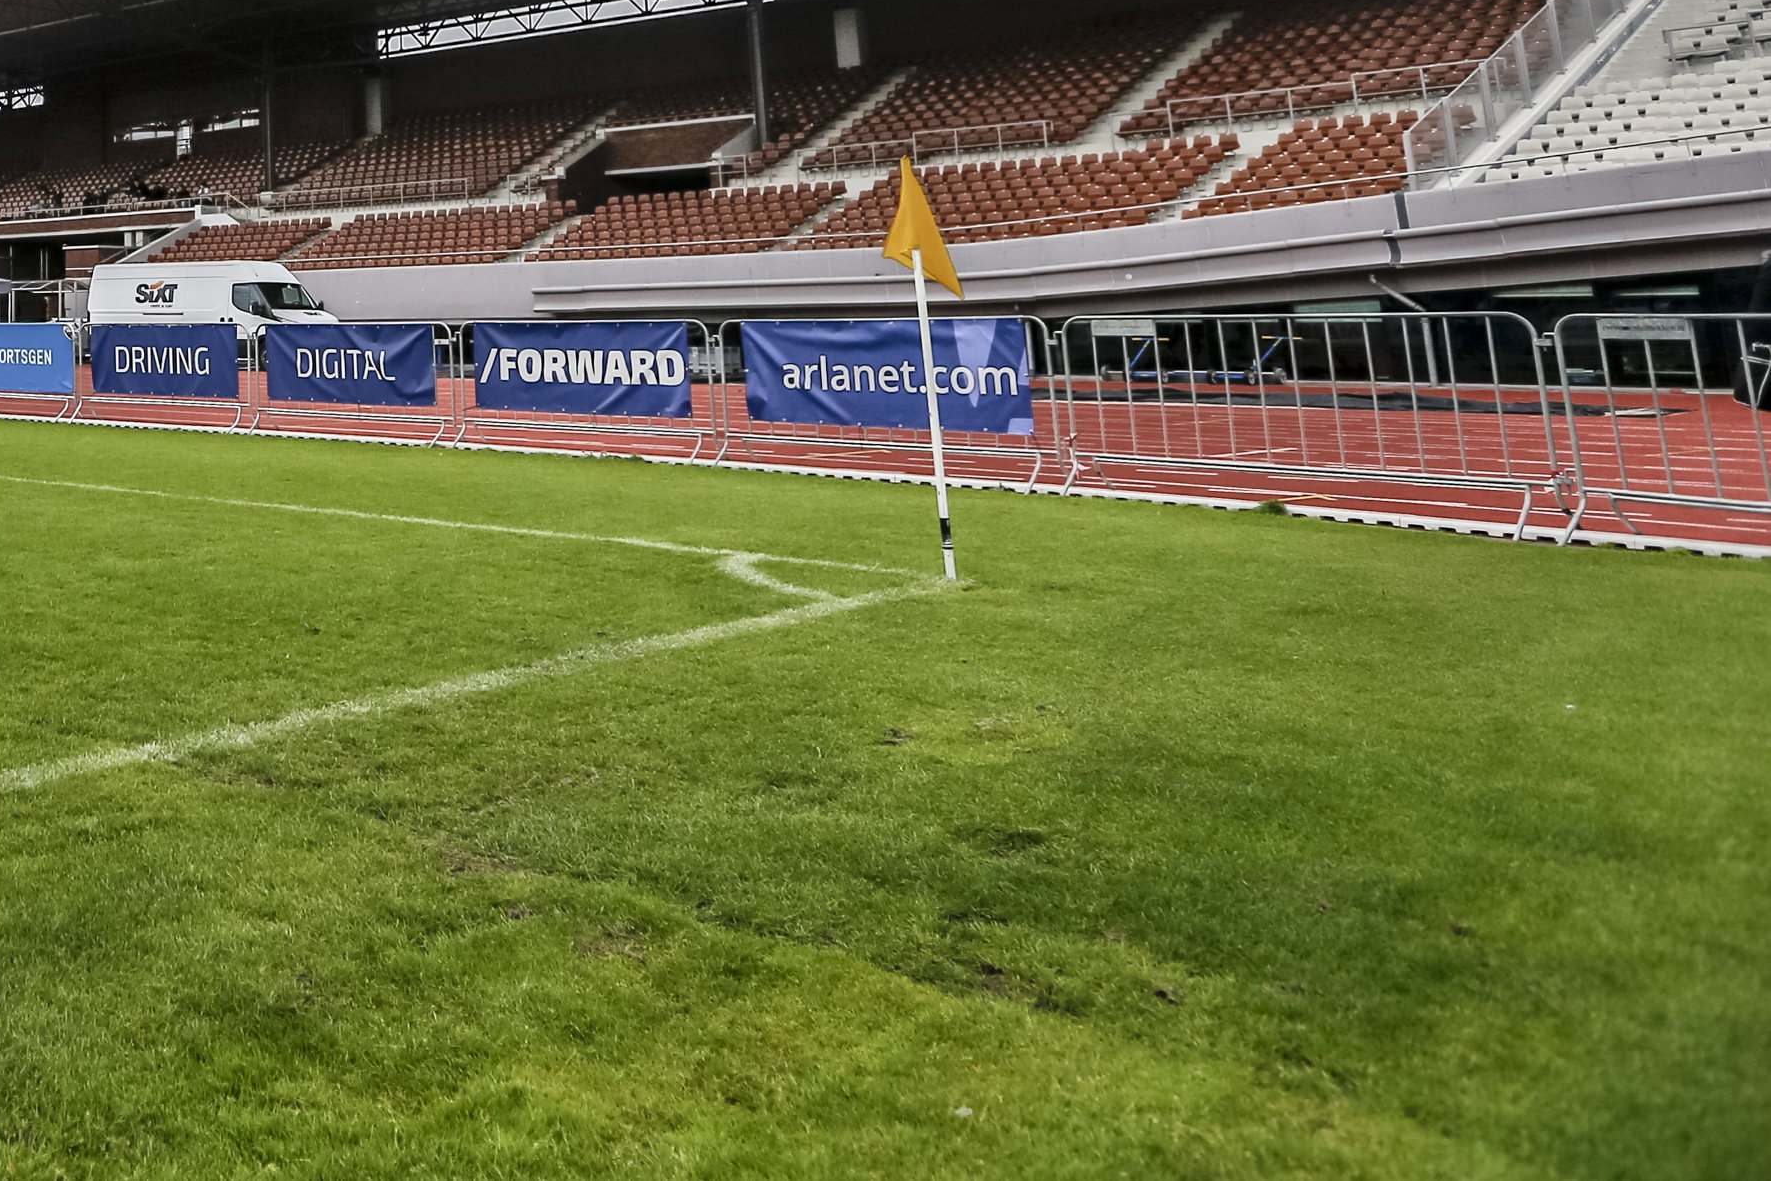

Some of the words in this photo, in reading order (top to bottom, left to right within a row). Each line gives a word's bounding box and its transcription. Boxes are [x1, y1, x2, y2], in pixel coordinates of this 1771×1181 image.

[114, 346, 210, 375] DRIVING
[296, 348, 396, 381] DIGITAL
[479, 348, 685, 386] /FORWARD
[782, 355, 1019, 396] arlanet.com
